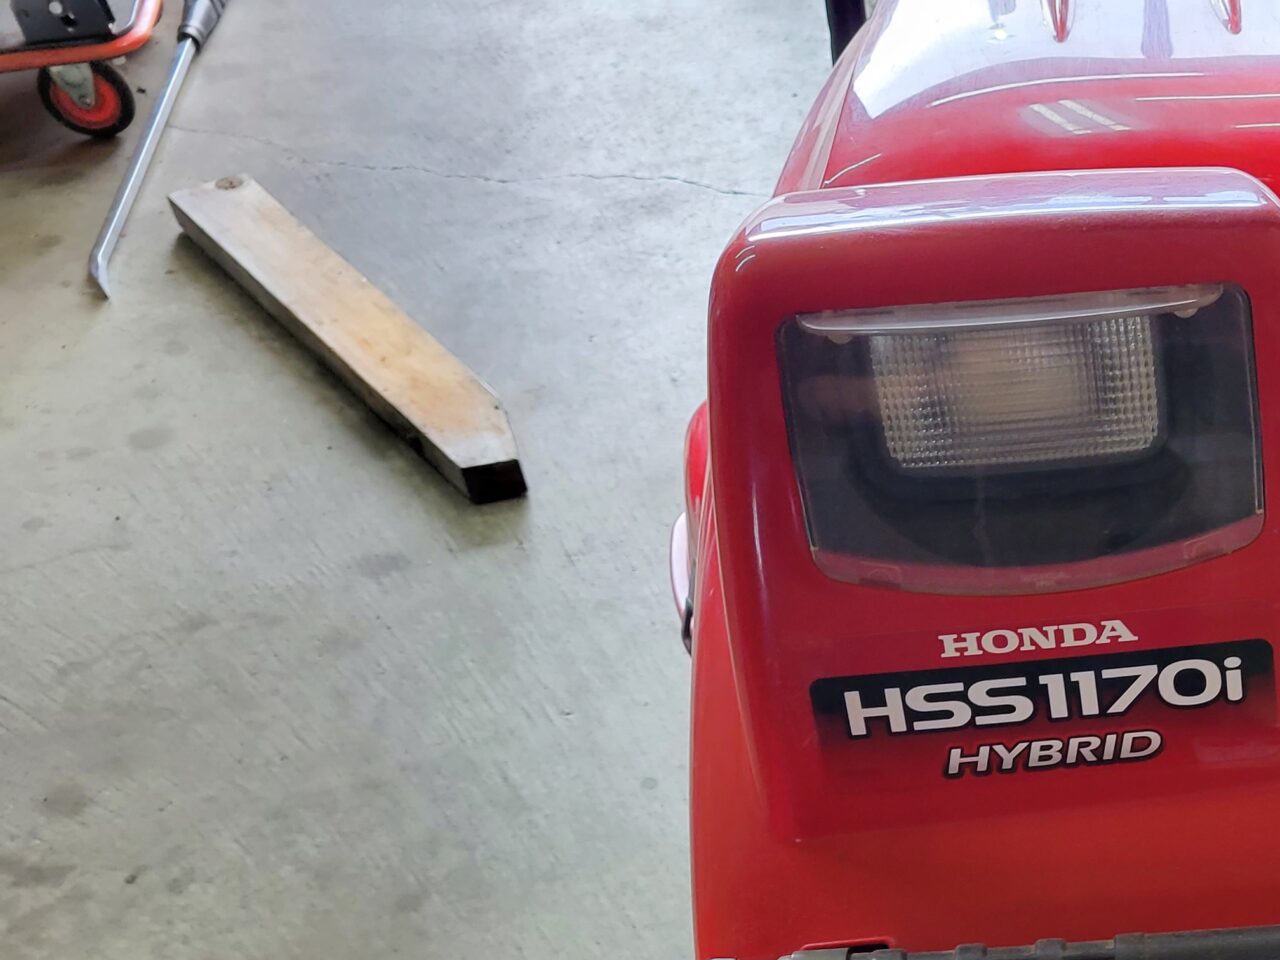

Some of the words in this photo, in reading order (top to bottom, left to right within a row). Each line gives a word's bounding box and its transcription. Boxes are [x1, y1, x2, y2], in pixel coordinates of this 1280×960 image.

[938, 619, 1138, 658] HONDA
[843, 656, 1243, 737] HSS1170i
[947, 730, 1163, 776] HYBRID
